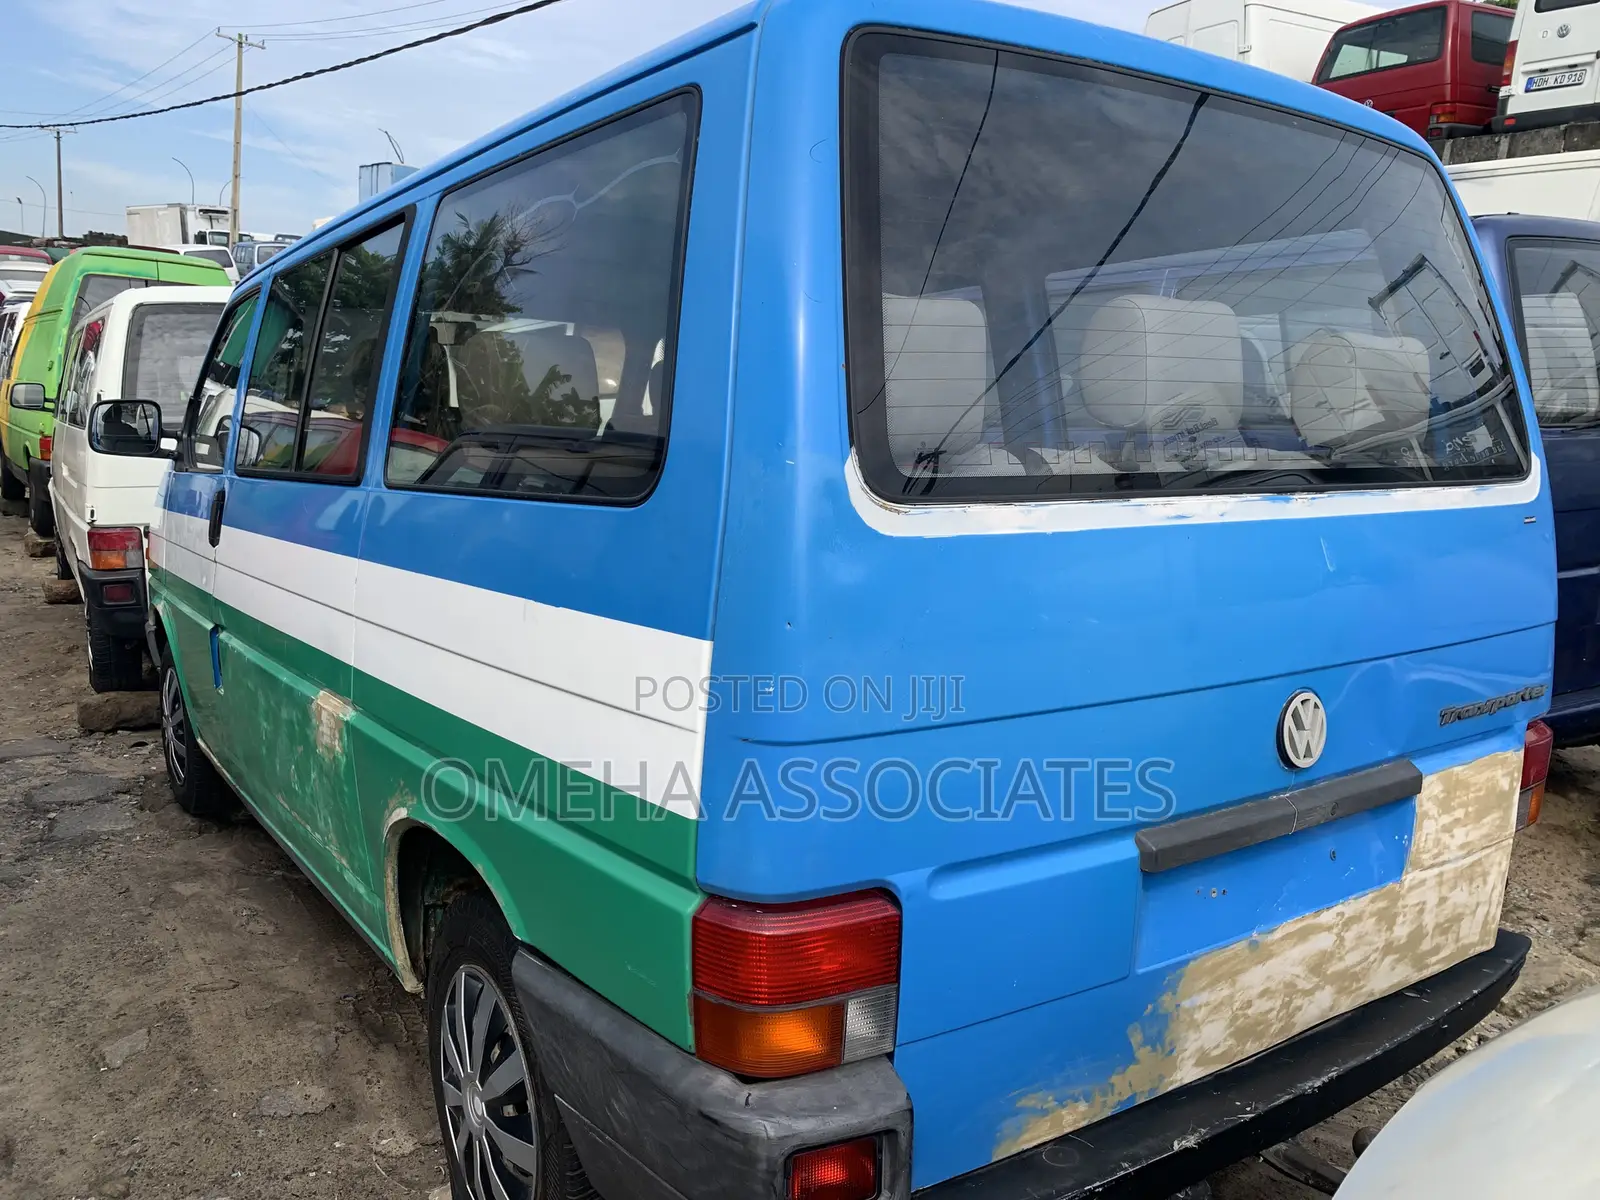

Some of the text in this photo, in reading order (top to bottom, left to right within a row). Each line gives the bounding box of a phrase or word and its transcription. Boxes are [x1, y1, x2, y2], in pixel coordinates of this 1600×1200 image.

[1532, 72, 1584, 88] HDH KD 918
[1281, 690, 1327, 768] VW
